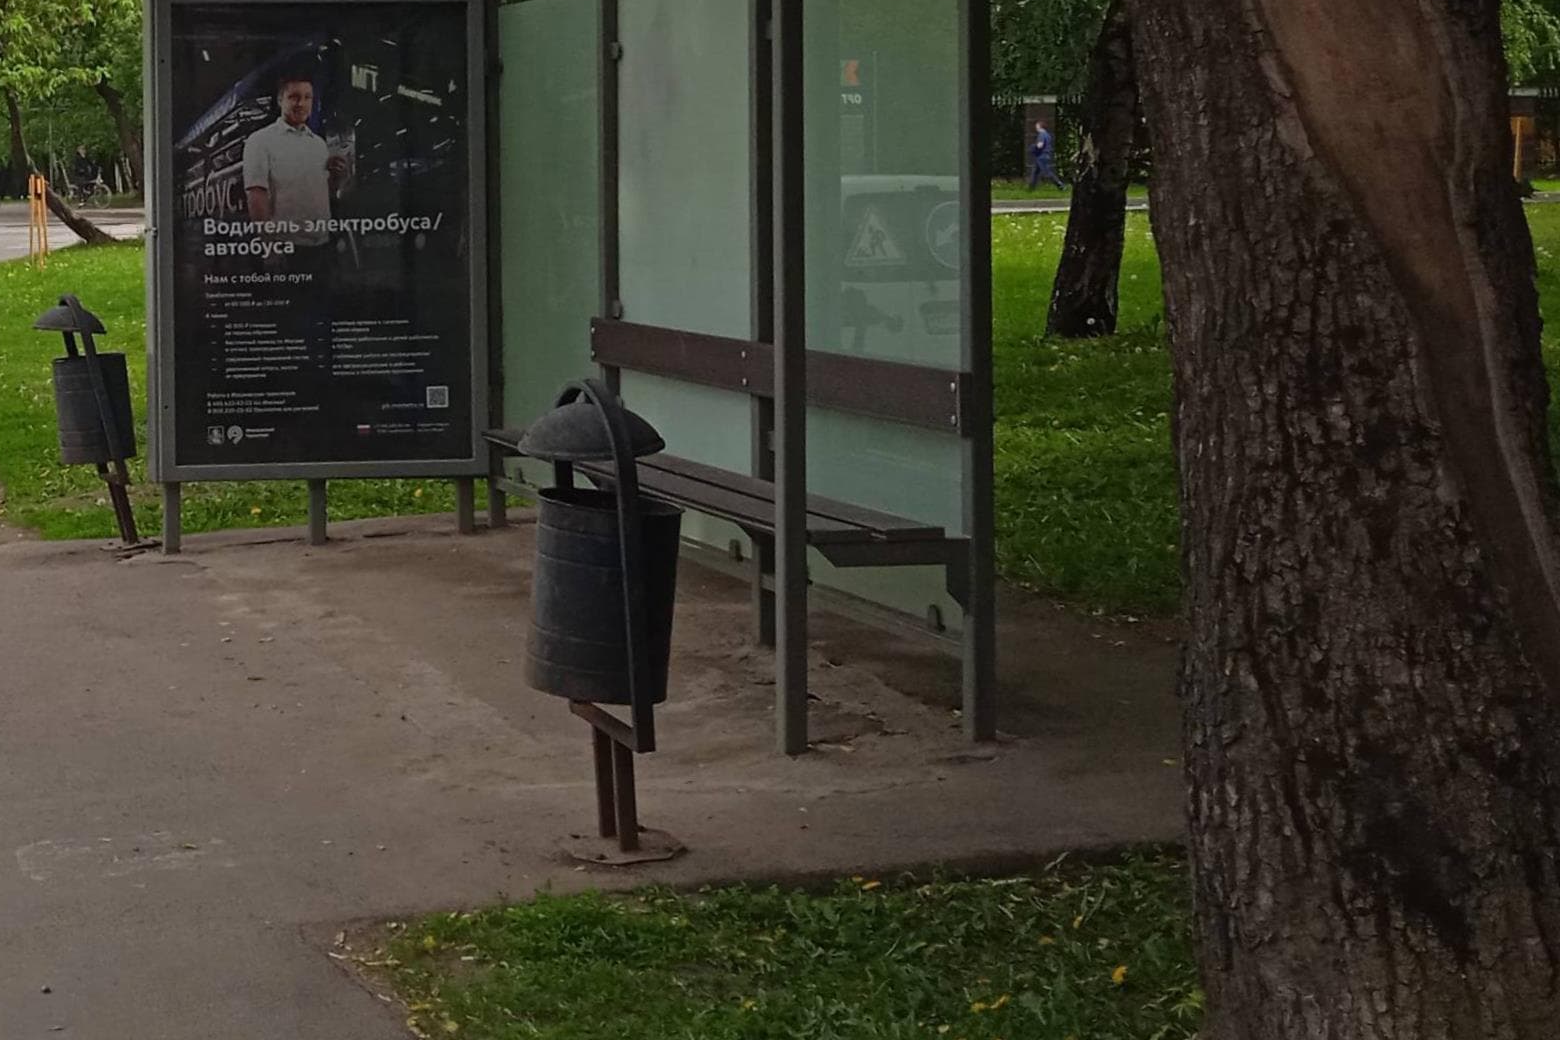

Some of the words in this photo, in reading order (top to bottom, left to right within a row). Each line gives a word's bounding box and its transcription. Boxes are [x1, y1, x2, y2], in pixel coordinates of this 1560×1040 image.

[203, 219, 299, 237] Водитель
[204, 237, 295, 258] автобуса
[204, 273, 228, 284] Нам
[239, 272, 271, 284] тобой
[273, 274, 286, 283] по
[288, 272, 312, 285] пути
